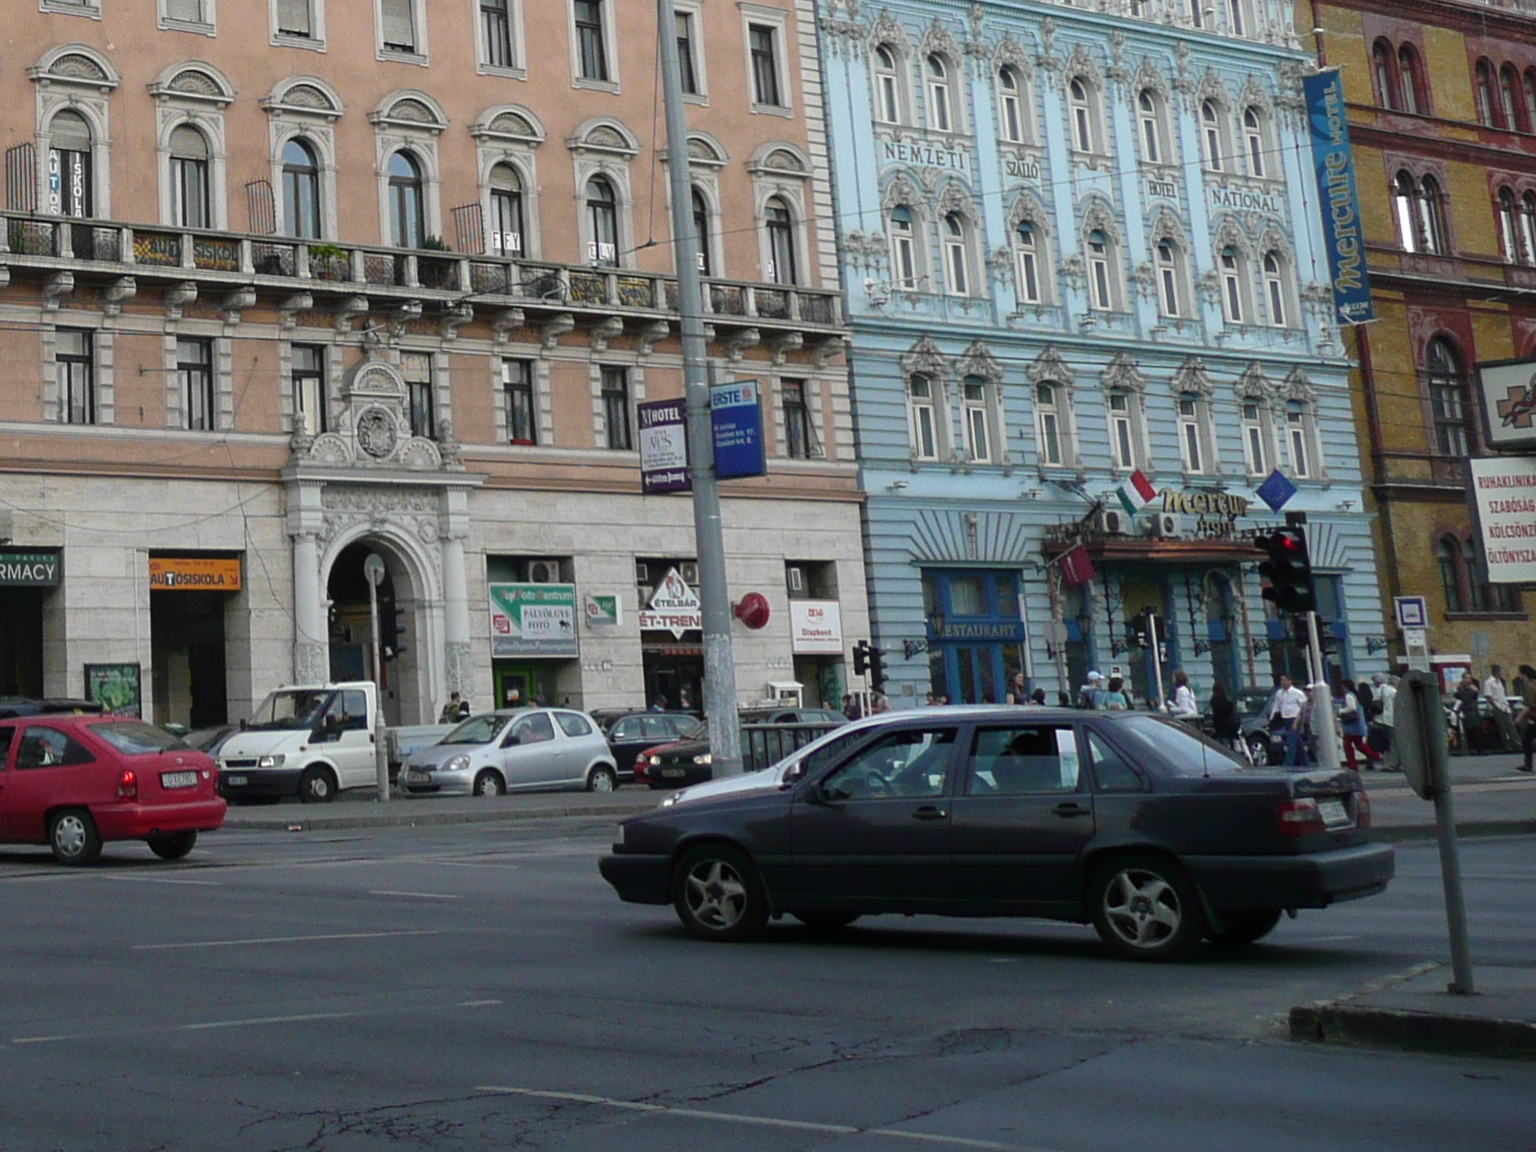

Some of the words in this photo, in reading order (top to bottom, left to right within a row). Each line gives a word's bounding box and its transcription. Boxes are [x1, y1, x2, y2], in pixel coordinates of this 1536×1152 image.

[1326, 80, 1338, 145] HOTEL
[884, 142, 966, 170] NEMZETI
[1006, 159, 1039, 181] SZÁLLÓ
[73, 152, 83, 218] ISKOLA
[1148, 179, 1177, 200] HOTEL
[1211, 189, 1280, 212] NATIONAL
[713, 389, 741, 407] ERSTE
[651, 407, 681, 422] HOTEL
[1488, 495, 1535, 514] SZABÓSÁG
[151, 570, 225, 586] AUTÓSISKOLA
[536, 589, 573, 601] Centrum
[654, 598, 697, 608] ÉTELBÁR
